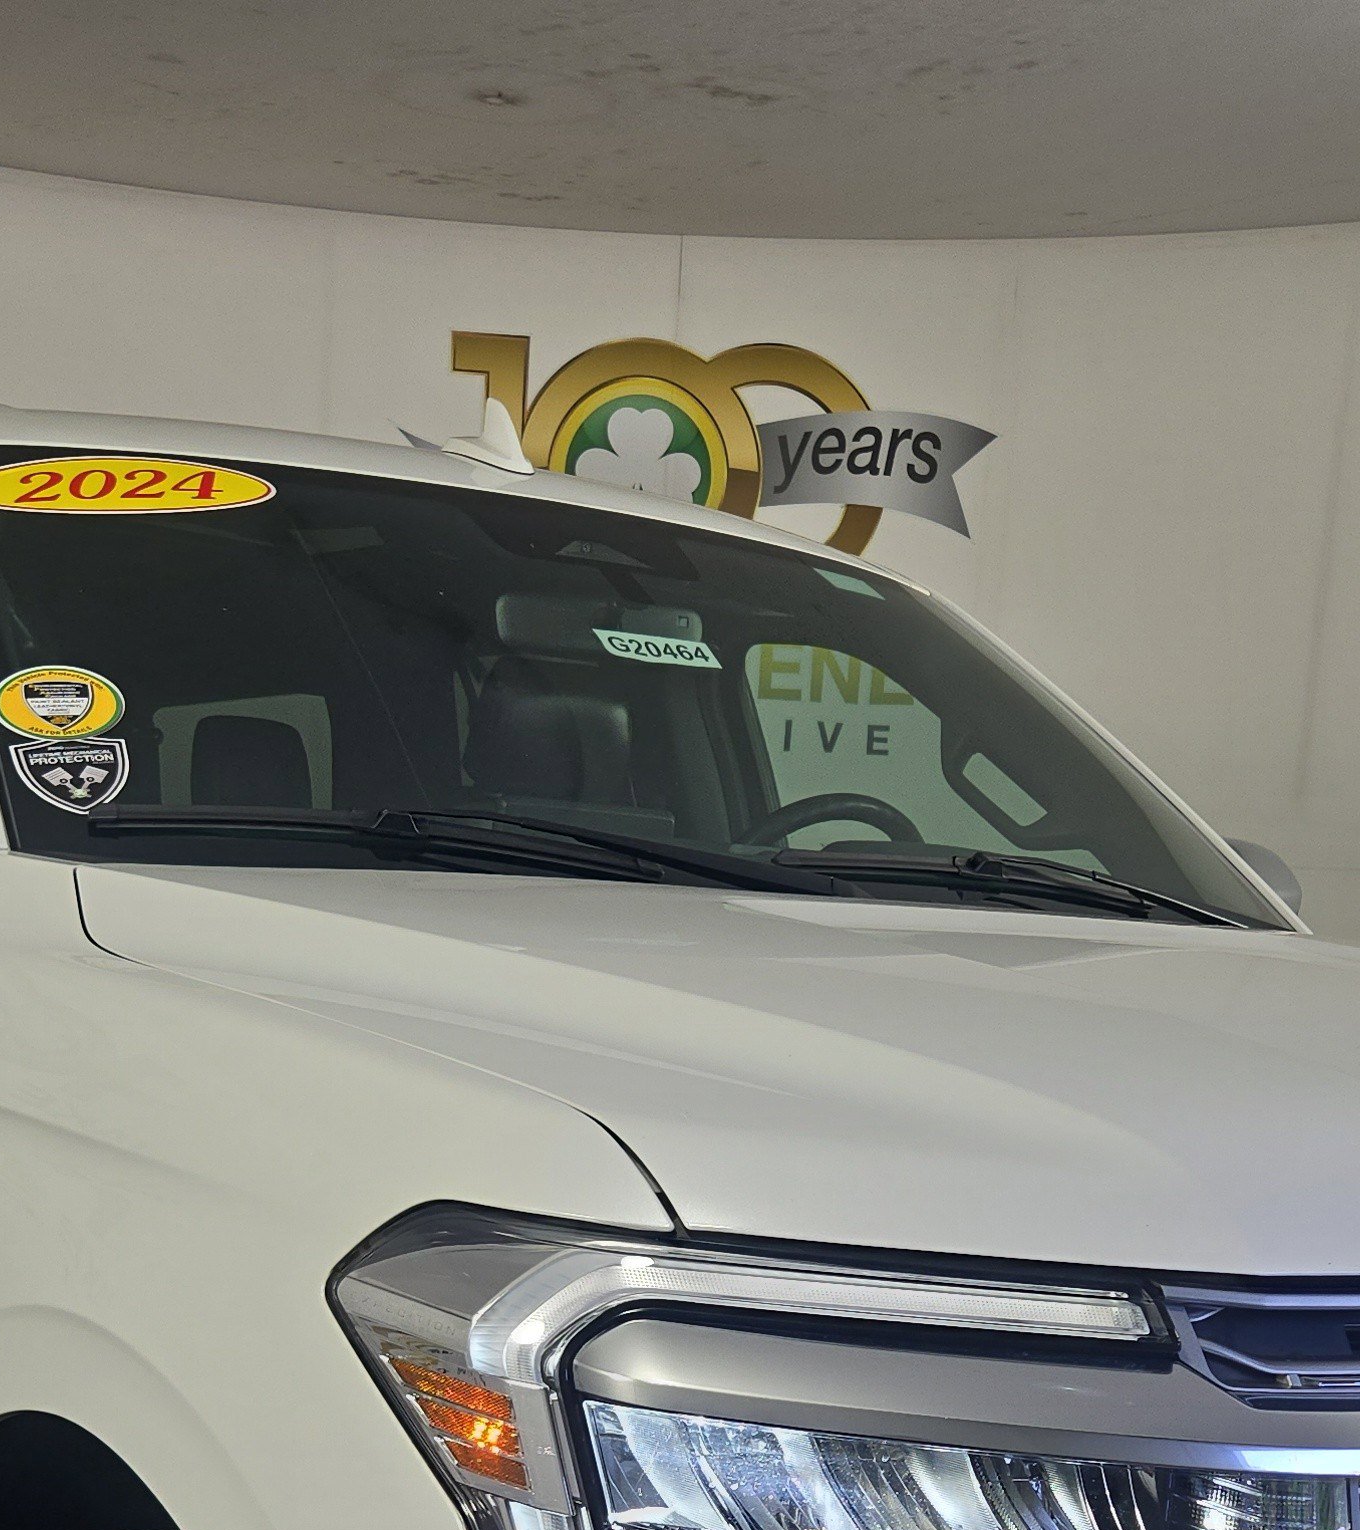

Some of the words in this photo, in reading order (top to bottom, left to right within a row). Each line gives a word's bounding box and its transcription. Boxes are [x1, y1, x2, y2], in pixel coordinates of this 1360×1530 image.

[772, 425, 942, 495] years
[14, 469, 224, 503] 2024
[608, 636, 710, 662] G20464
[29, 753, 115, 766] PROTECTION
